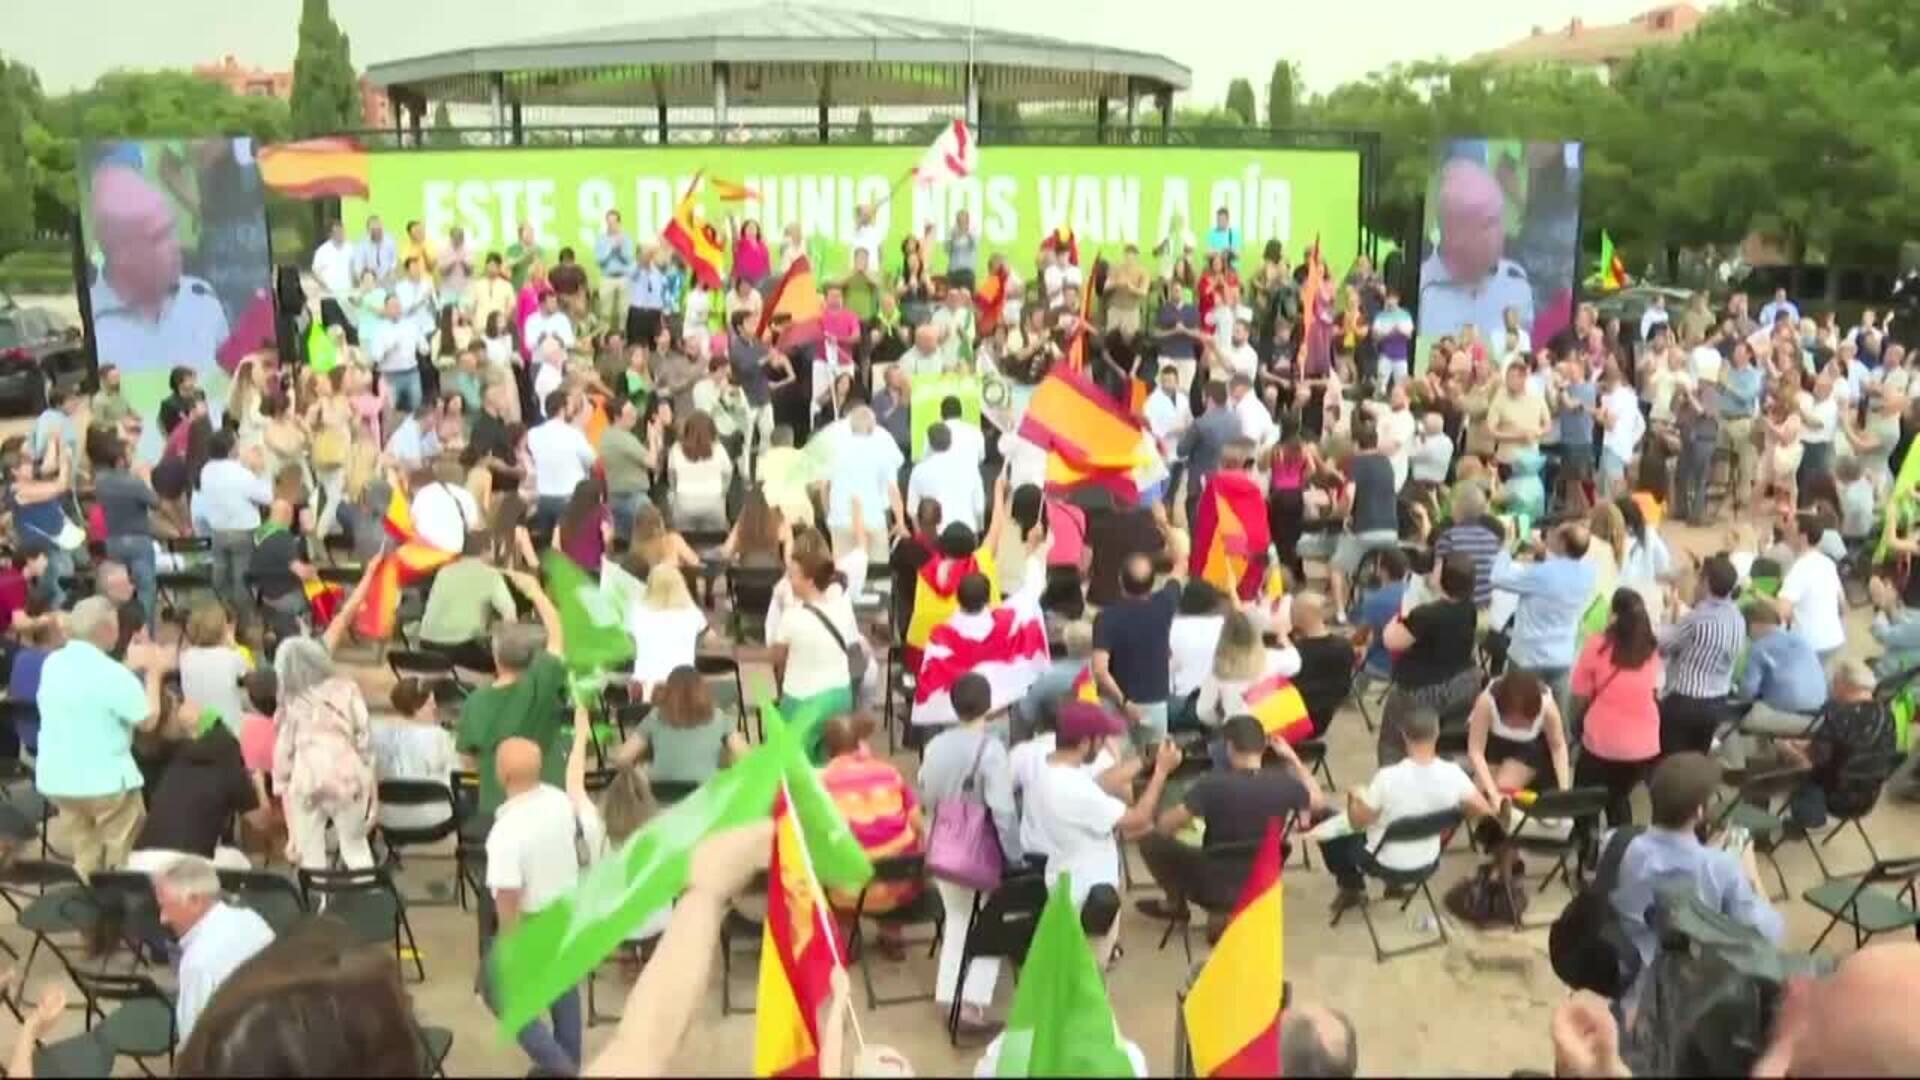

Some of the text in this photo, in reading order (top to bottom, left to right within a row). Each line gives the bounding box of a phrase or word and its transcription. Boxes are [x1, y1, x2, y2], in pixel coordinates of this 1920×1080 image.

[424, 176, 556, 248] ESTE
[578, 176, 617, 243] 9
[636, 175, 706, 242] D
[912, 173, 1018, 243] NOS
[1037, 174, 1140, 243] VAN
[1156, 175, 1196, 243] A
[1208, 160, 1291, 243] OÍR
